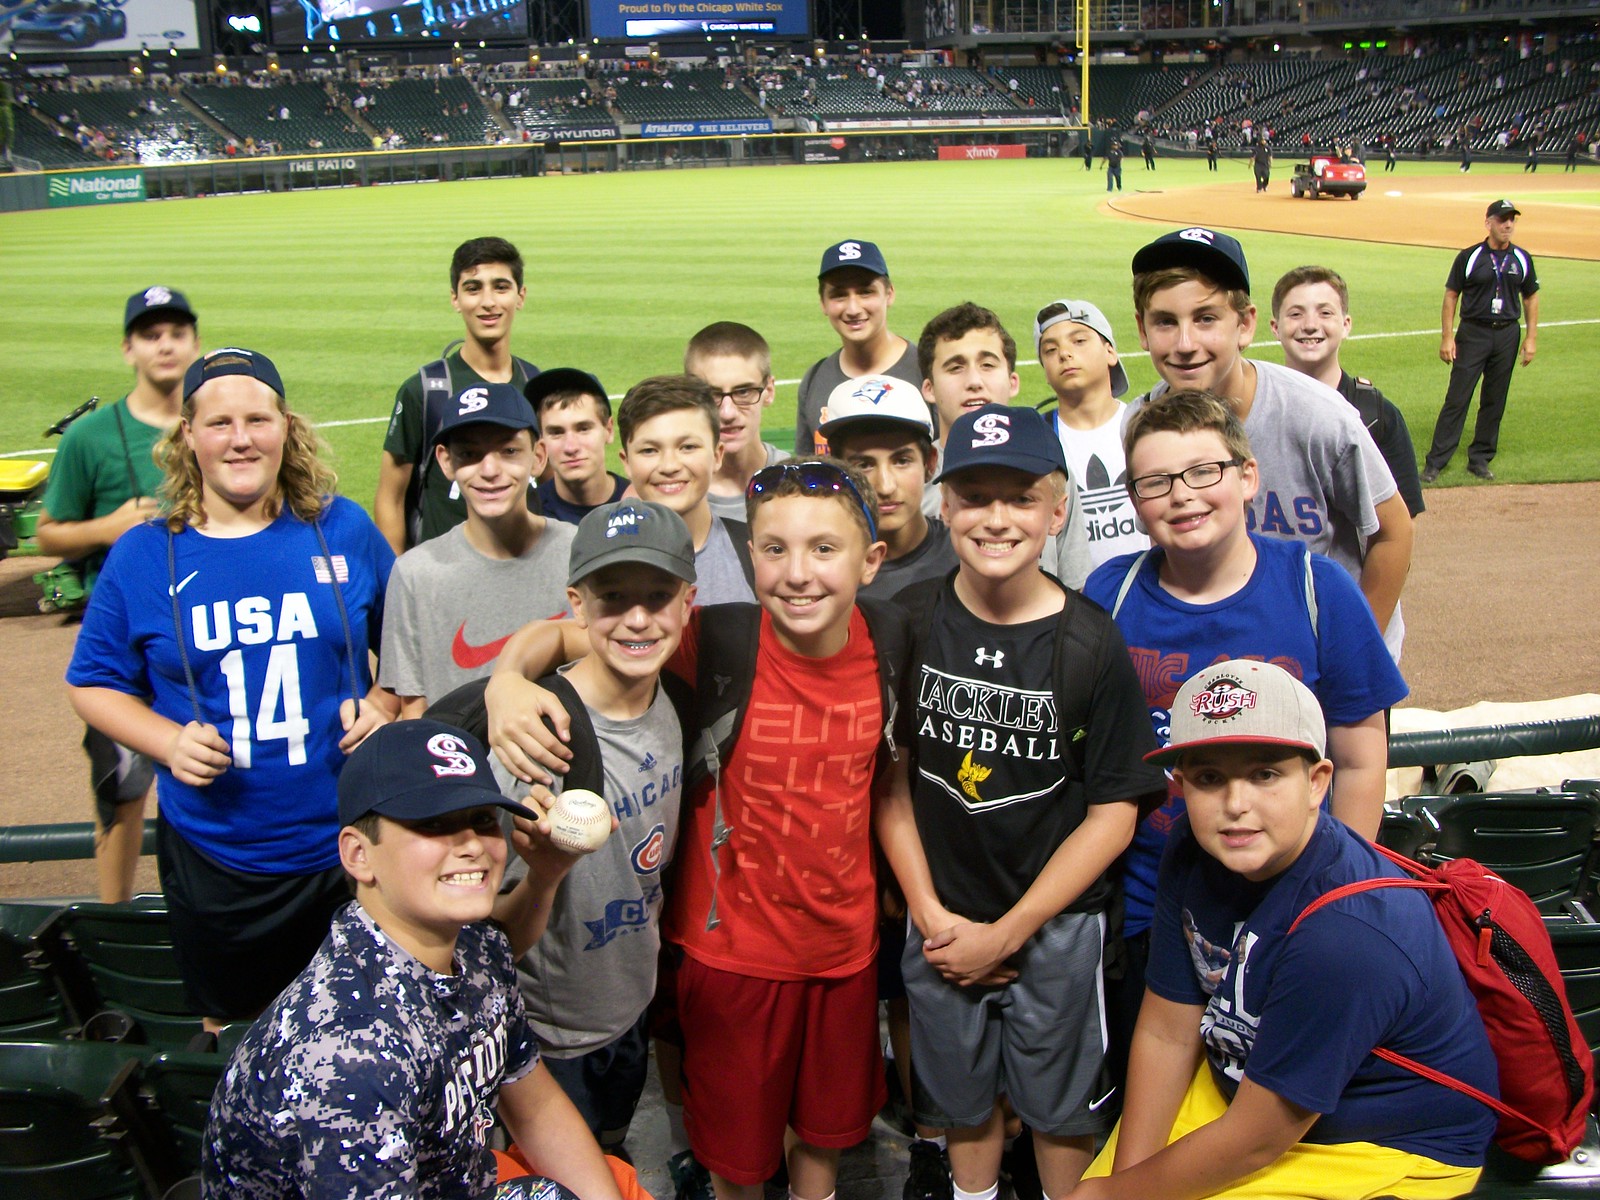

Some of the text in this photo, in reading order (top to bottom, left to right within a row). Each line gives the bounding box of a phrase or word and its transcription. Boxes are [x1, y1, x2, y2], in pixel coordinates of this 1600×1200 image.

[619, 3, 783, 13] Proud to fly the Chicago White Sox
[553, 129, 616, 139] HYUNDAI
[645, 124, 695, 133] ATHLETICO
[700, 123, 769, 133] THE RELIEVERS
[966, 147, 999, 159] xfinity
[289, 159, 356, 172] THE PATIO
[70, 174, 142, 193] National
[1086, 516, 1136, 542] dida
[191, 592, 319, 652] USA
[219, 643, 310, 768] 14
[1189, 690, 1257, 717] RUSH
[918, 713, 1060, 760] ASEBALL
[1220, 1016, 1257, 1039] JUDG
